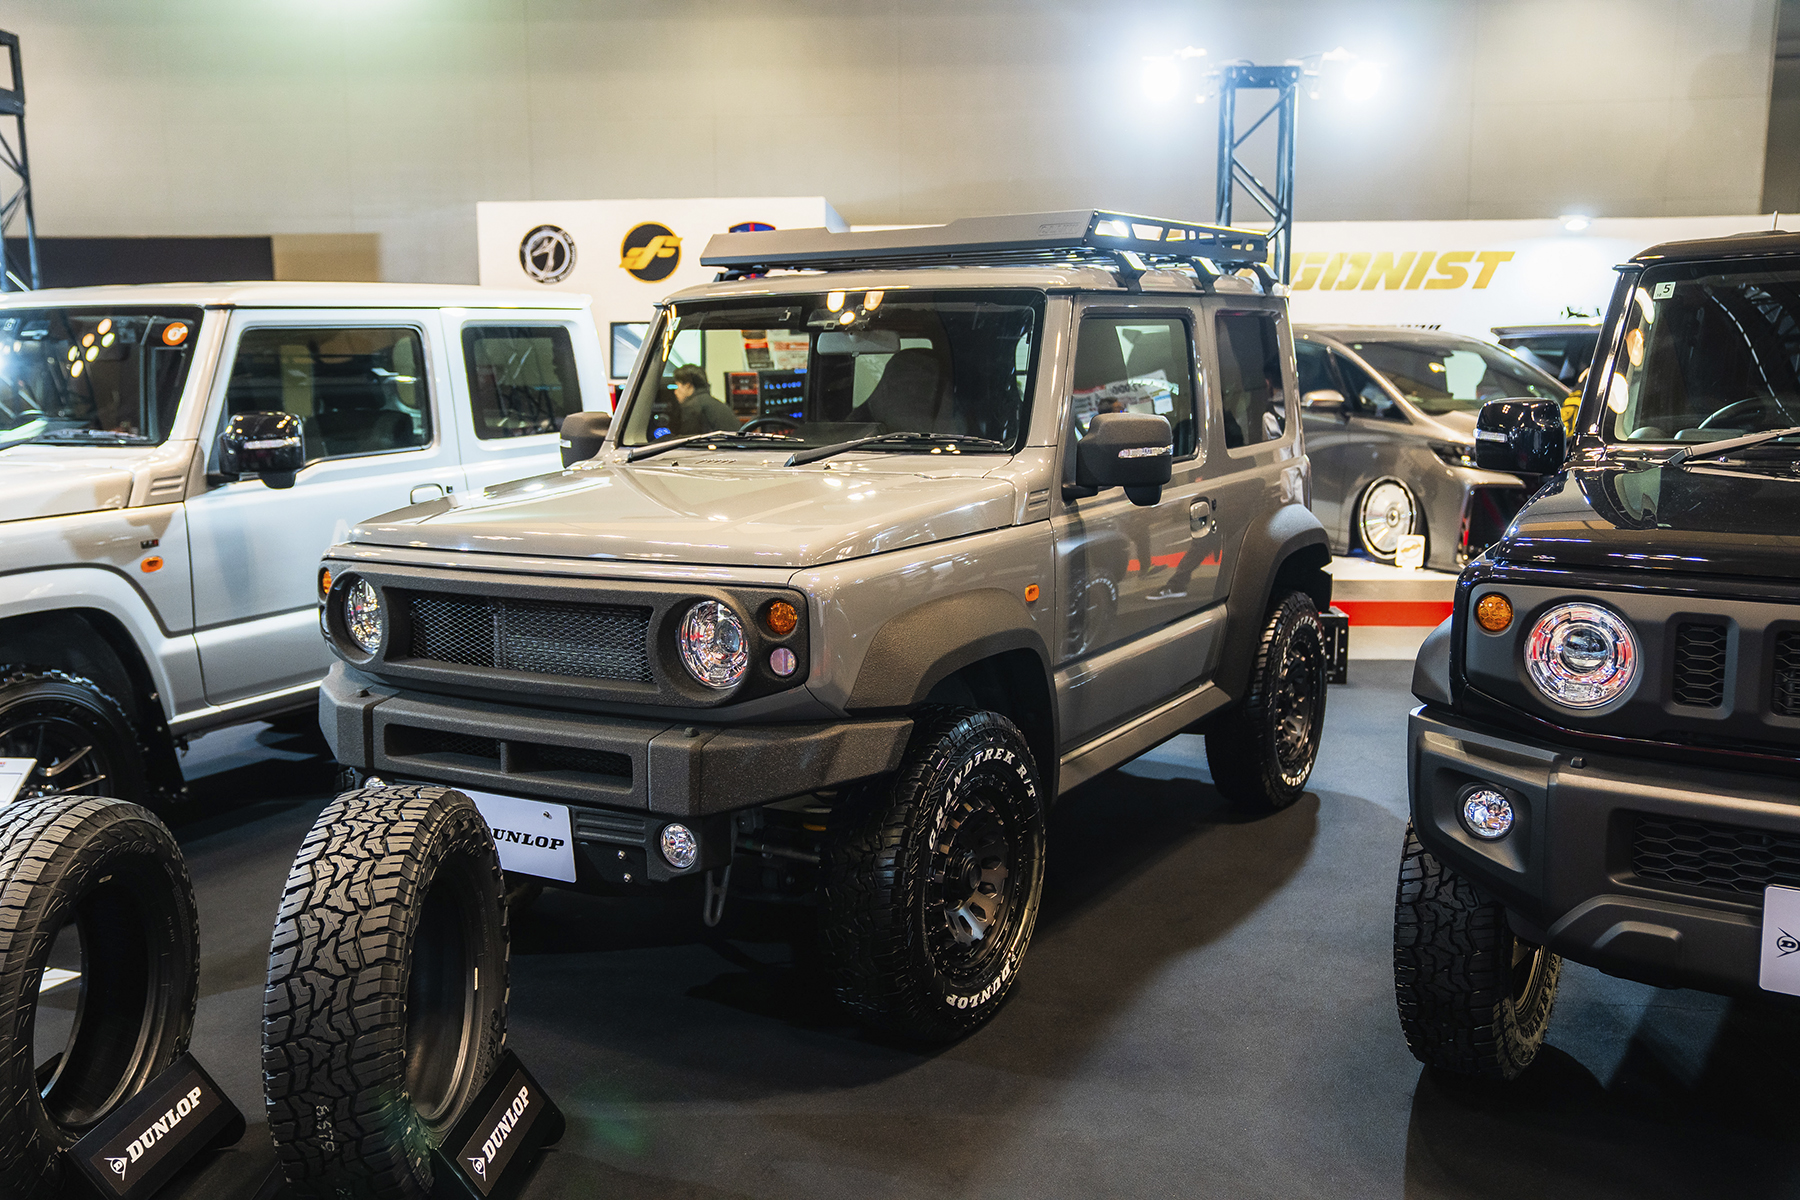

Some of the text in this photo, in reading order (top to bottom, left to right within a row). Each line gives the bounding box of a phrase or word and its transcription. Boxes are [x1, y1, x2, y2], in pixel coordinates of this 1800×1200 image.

[1291, 251, 1515, 291] GONIST
[1663, 284, 1671, 294] 5
[928, 748, 1036, 850] GRANDTREK R/T
[493, 828, 565, 851] UNLOP
[946, 957, 1012, 1010] DUNLOP
[126, 1086, 202, 1164] DUNLOP
[482, 1085, 530, 1164] DUNLOP
